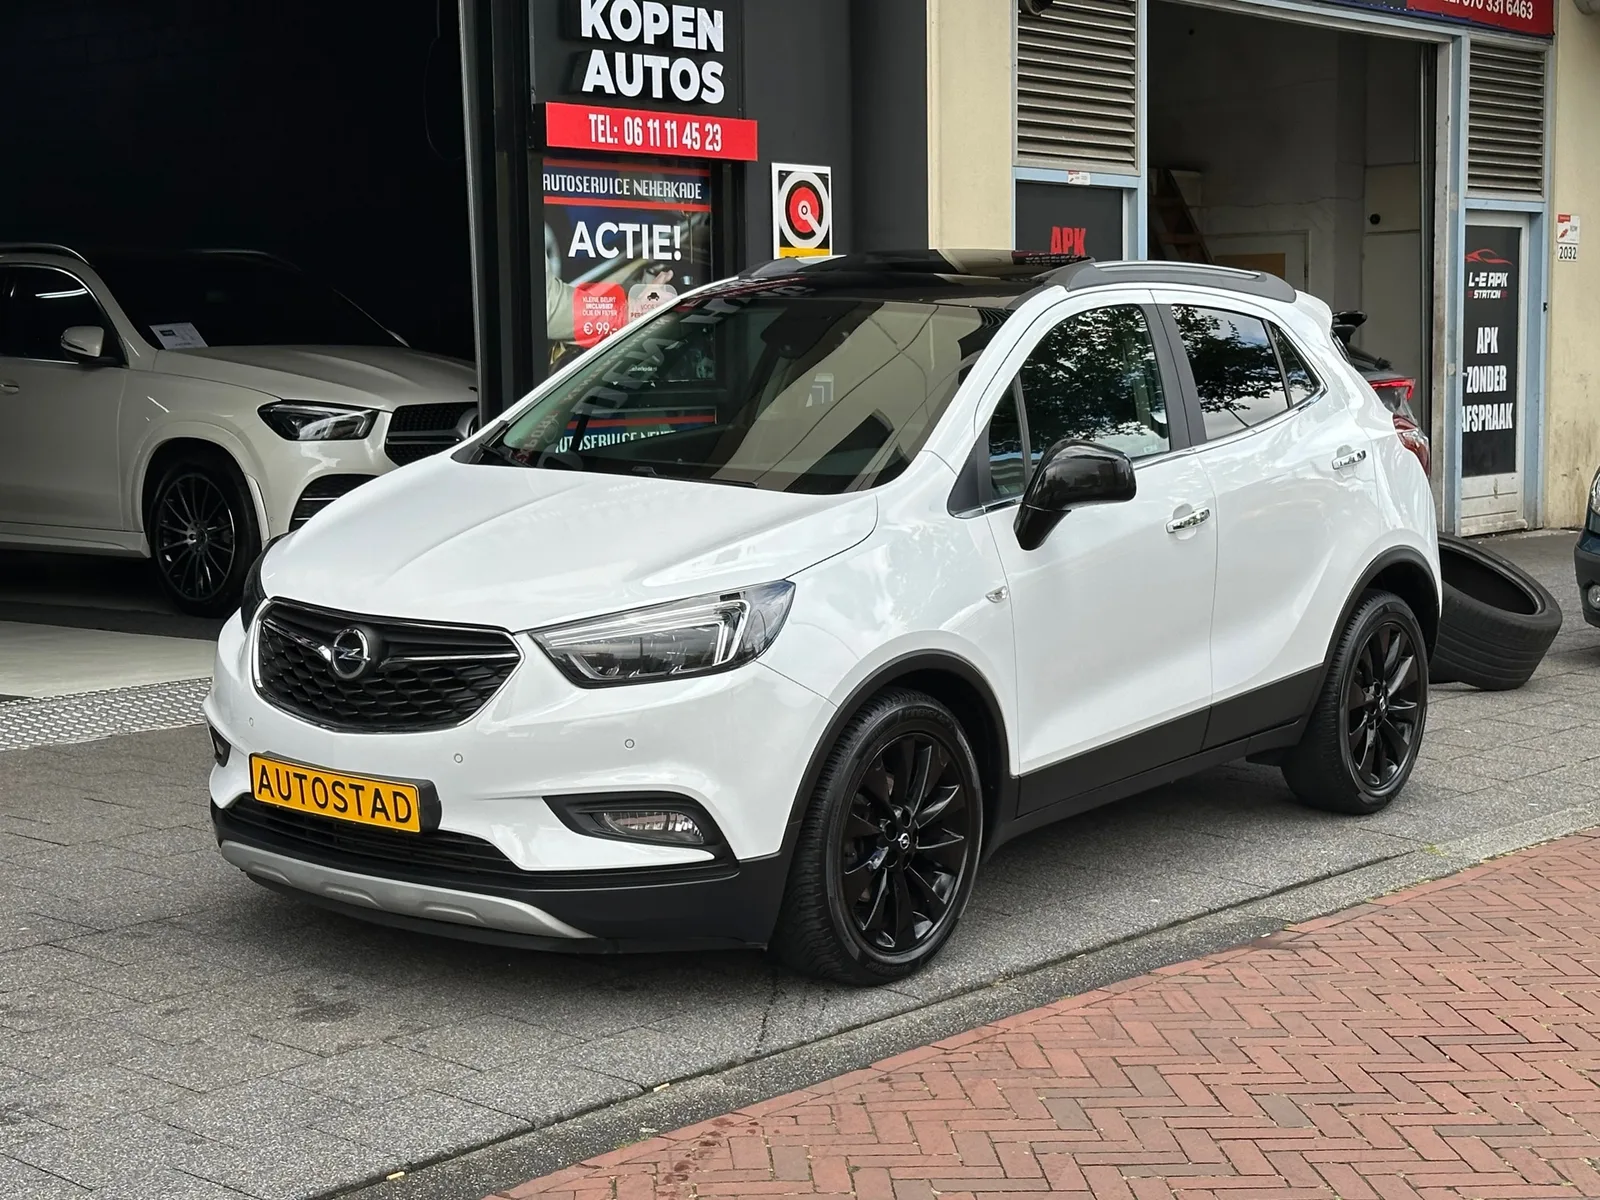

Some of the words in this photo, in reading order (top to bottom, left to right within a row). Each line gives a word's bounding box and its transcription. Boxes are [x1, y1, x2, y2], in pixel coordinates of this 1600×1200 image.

[1506, 0, 1533, 20] 6463
[581, 0, 724, 52] KOPEN
[582, 49, 724, 104] AUTOS
[588, 113, 618, 144] TEL:
[624, 116, 643, 146] 06
[647, 118, 660, 147] 11
[664, 120, 677, 148] 11
[682, 122, 701, 150] 45
[705, 123, 722, 152] 23
[543, 173, 630, 196] AUTOSERVICE
[633, 179, 702, 200] NEHERKADE
[568, 220, 682, 261] ACTIE!
[1051, 226, 1086, 256] APK
[1559, 246, 1577, 260] 2032
[1488, 272, 1508, 287] APK
[1473, 290, 1501, 299] STATION
[583, 322, 593, 335] €
[1476, 326, 1499, 354] APK
[1466, 365, 1507, 393] ZONDER
[1461, 402, 1514, 433] AFSPRAAK
[257, 764, 413, 824] AUTOSTAD
